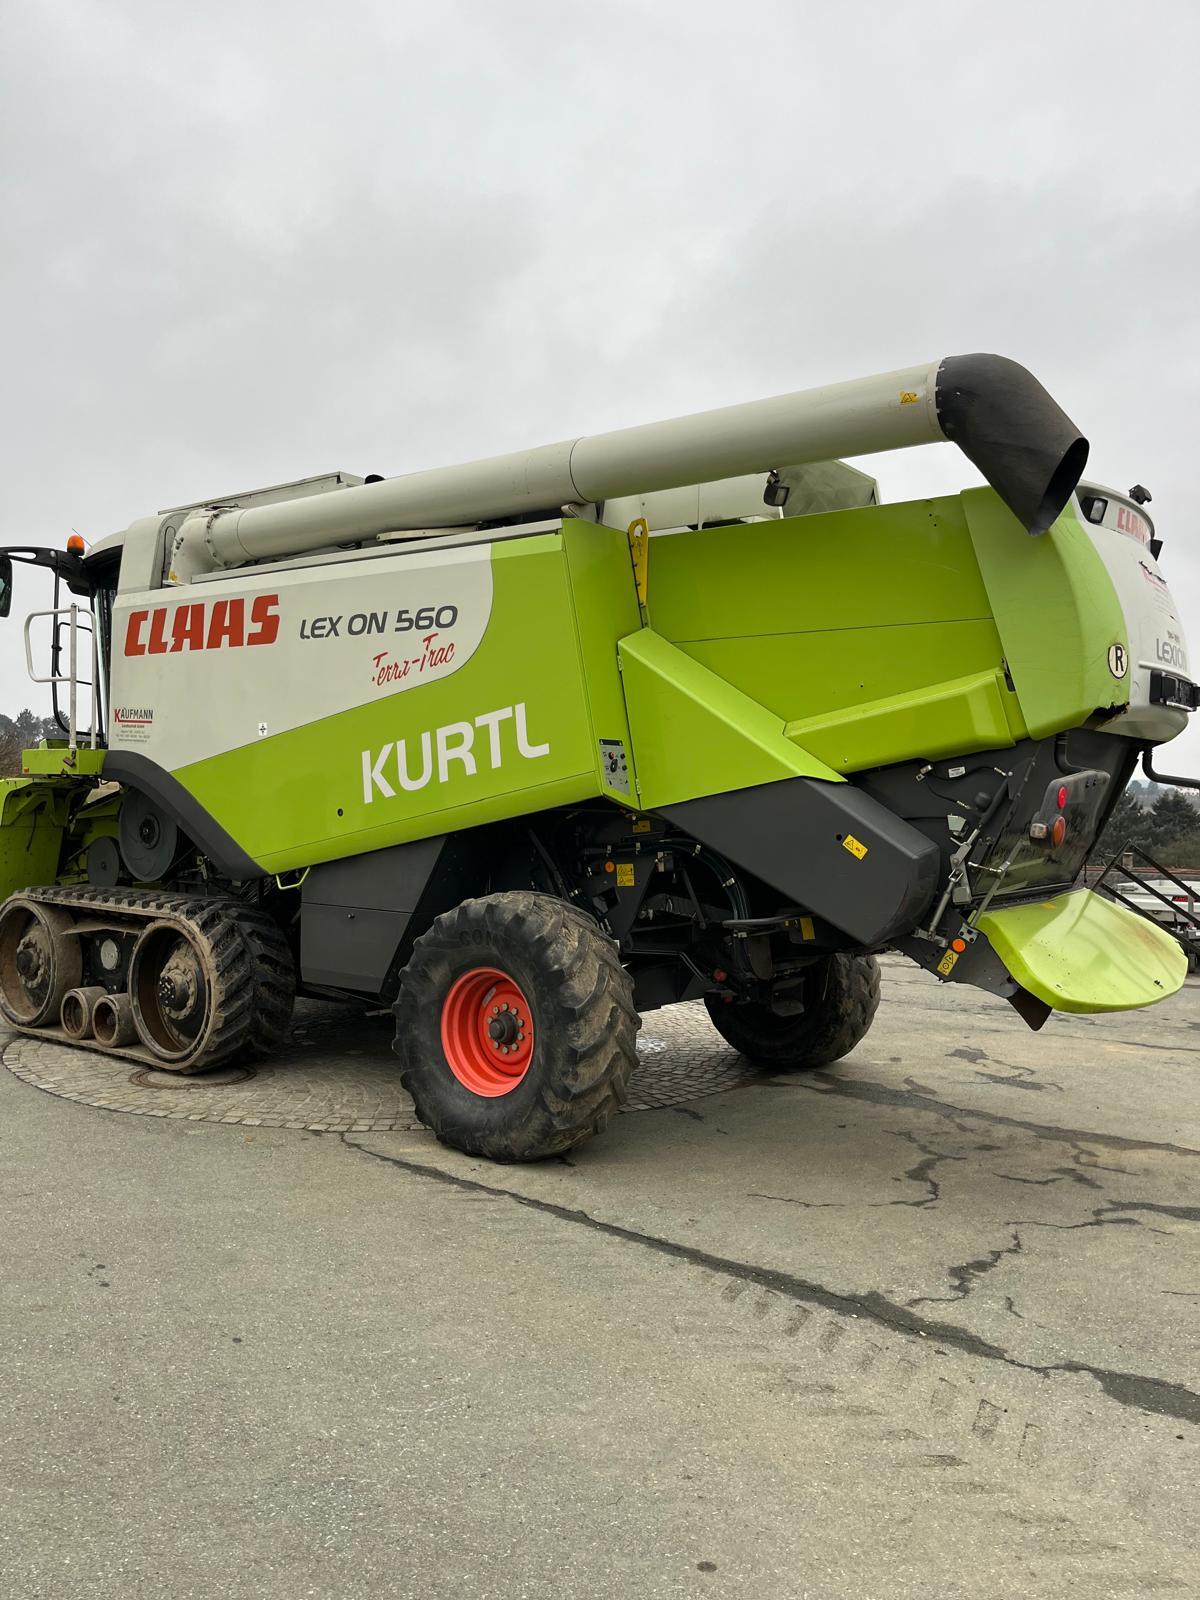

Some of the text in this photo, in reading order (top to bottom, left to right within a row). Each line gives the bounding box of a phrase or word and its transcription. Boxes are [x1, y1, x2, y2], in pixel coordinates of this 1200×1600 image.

[124, 594, 280, 657] CLAAS
[395, 605, 458, 632] 560
[372, 633, 455, 686] Terra-Trac
[1115, 646, 1124, 672] R
[114, 708, 153, 723] KAUFMANN
[361, 702, 550, 804] KURTL
